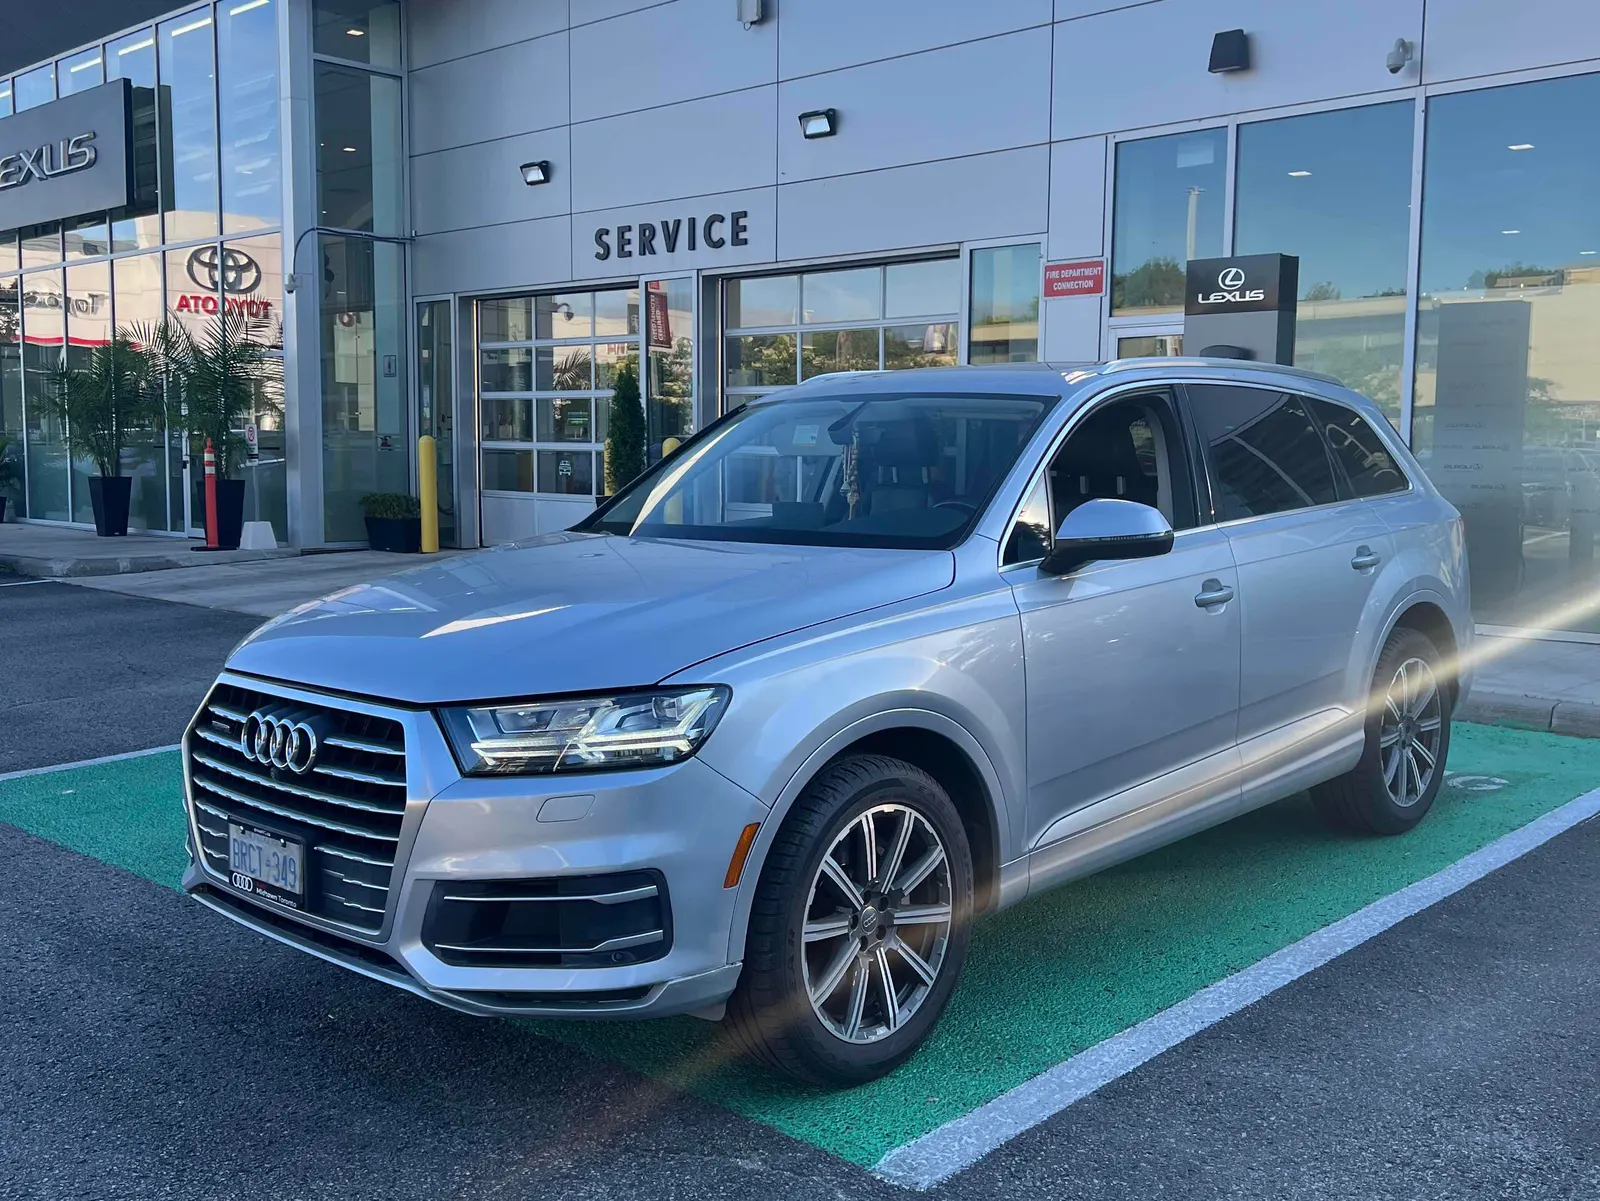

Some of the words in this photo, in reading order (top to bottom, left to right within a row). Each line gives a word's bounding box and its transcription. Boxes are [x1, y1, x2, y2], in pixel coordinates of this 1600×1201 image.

[595, 211, 748, 261] SERVICE
[1046, 271, 1060, 279] FIRE
[1061, 267, 1102, 278] DEPARTMENT
[1053, 280, 1094, 291] CONNECTION
[1198, 290, 1264, 303] LEXUS
[233, 838, 263, 878] BRCT
[272, 851, 297, 889] 349
